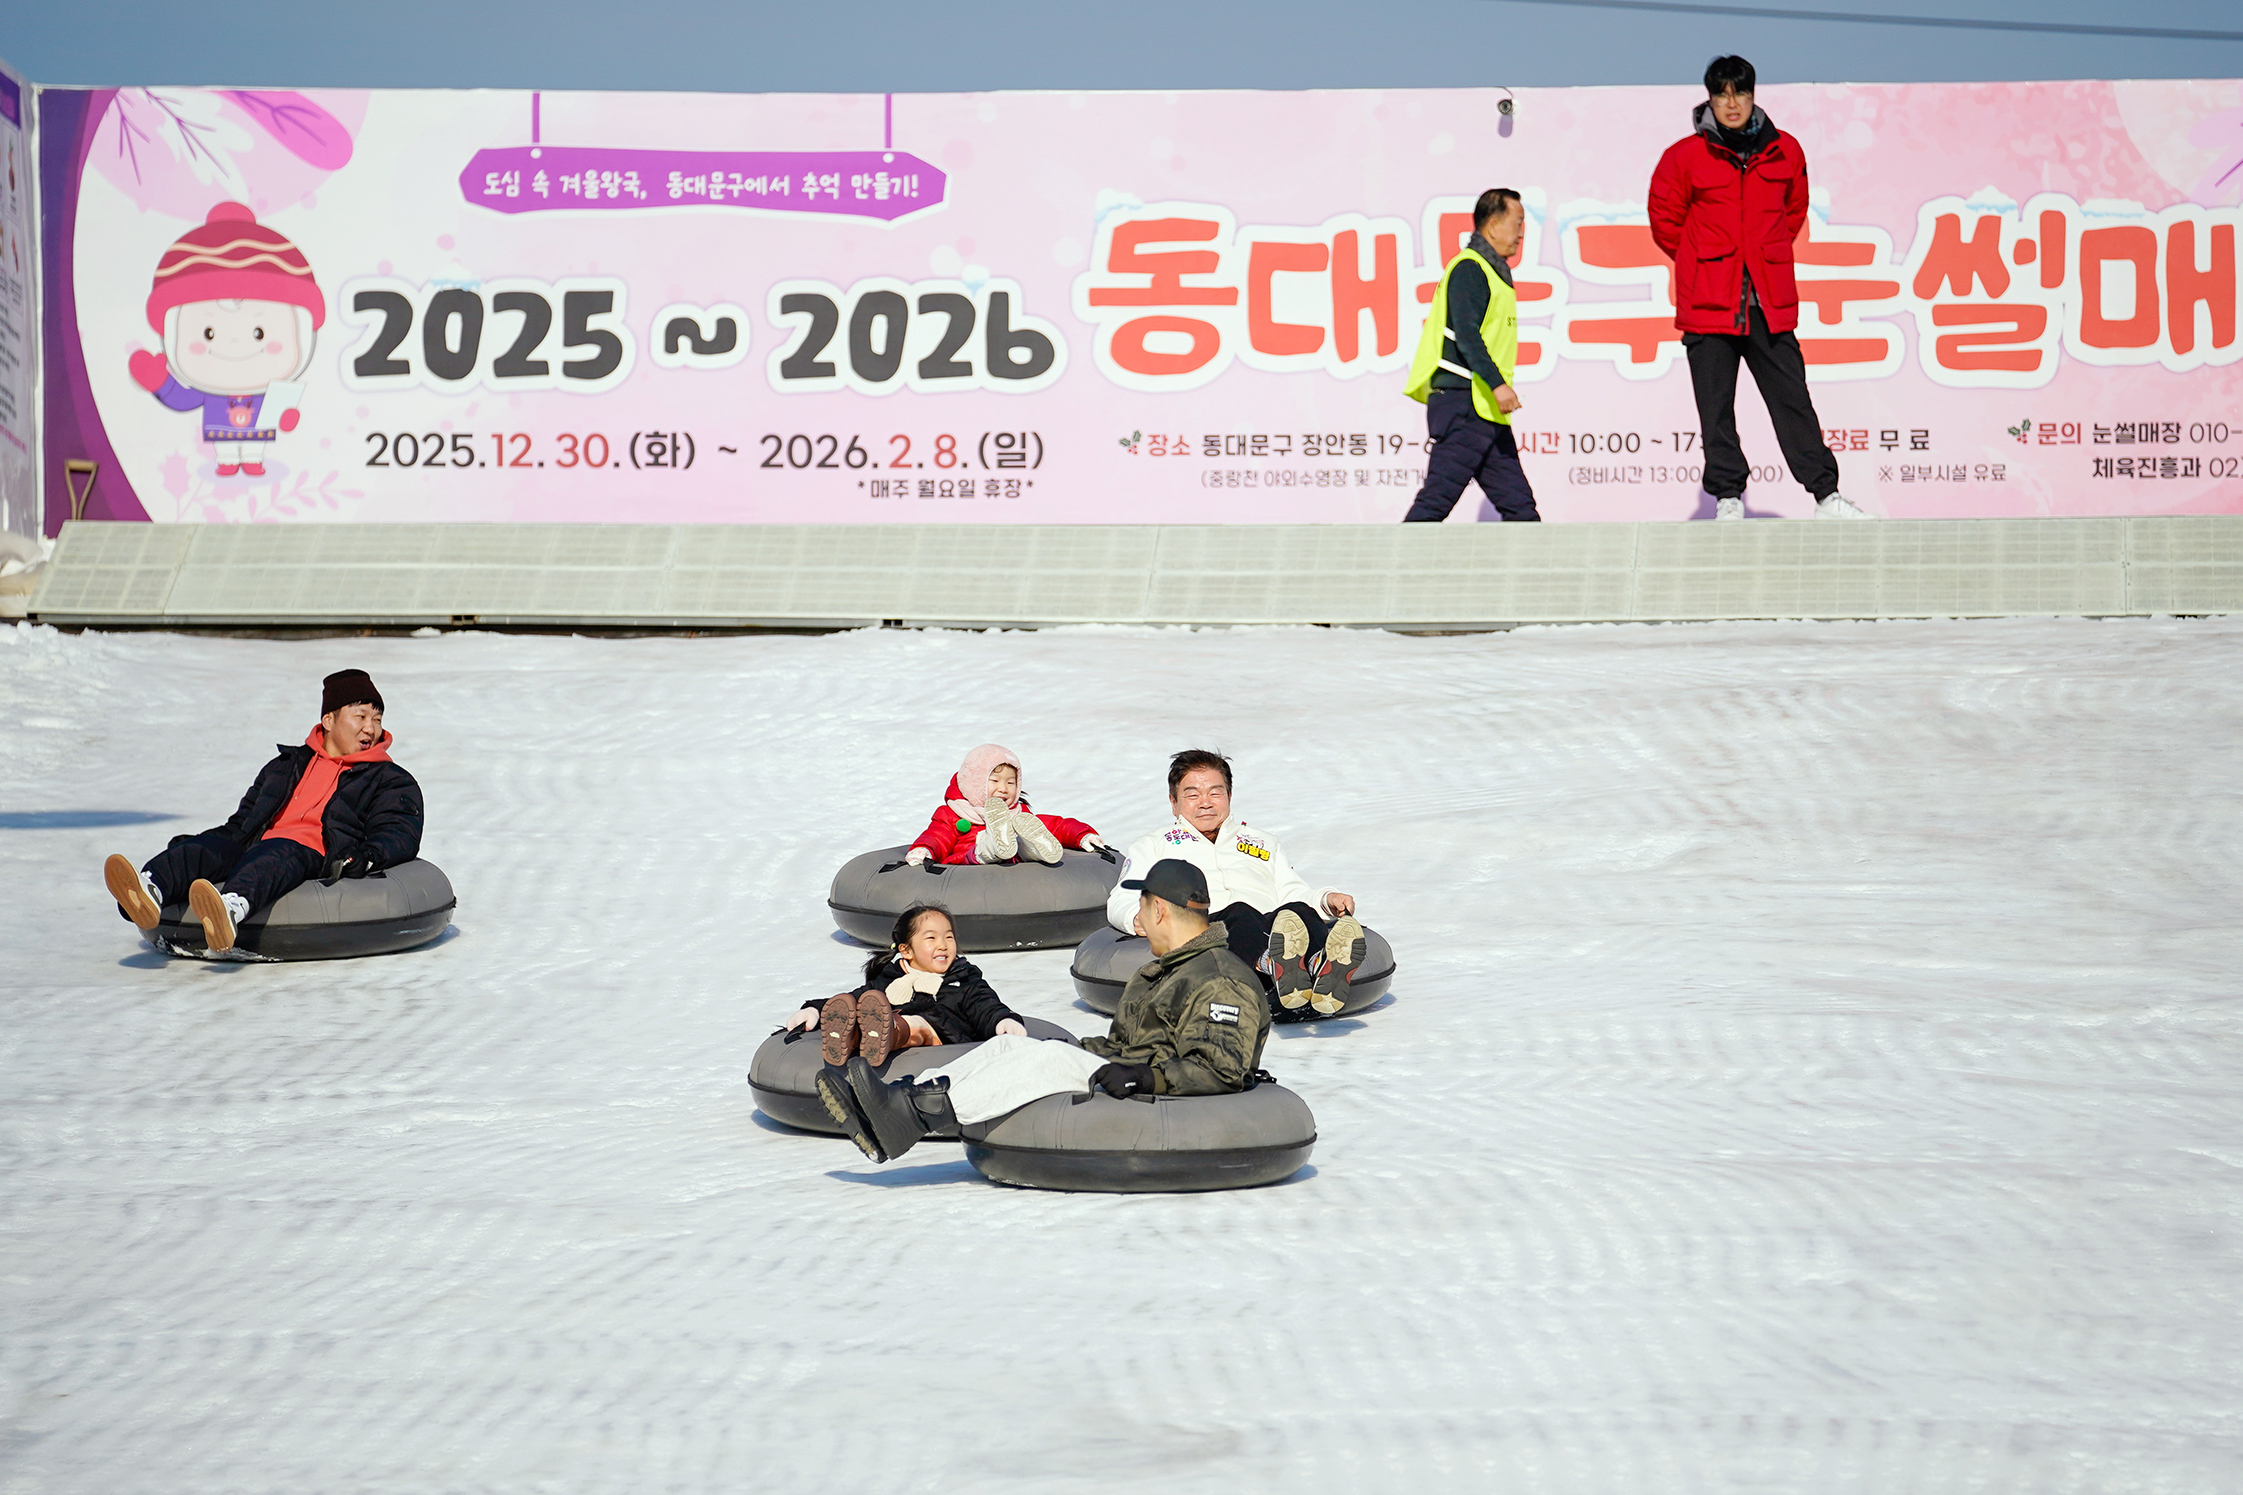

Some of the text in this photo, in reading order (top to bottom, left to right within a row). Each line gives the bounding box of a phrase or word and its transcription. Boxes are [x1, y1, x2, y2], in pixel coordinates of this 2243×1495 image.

[483, 168, 919, 201] 도심 속 겨울왕국, 동대문구에서 추억 만들기!
[353, 288, 623, 380] 2025
[780, 290, 1055, 382] 2026
[1147, 434, 1191, 457] 장소
[1202, 434, 1293, 457] 동대문구
[1302, 433, 1368, 457] 장안동
[1569, 432, 1641, 454] 10:00
[1821, 429, 1869, 451] 장료
[2037, 422, 2243, 446] 문의 눈썰매장 010-
[1200, 469, 1258, 489] (중랑천
[1263, 468, 1348, 488] 야외수영장
[1354, 469, 1370, 487] 및
[1568, 465, 1643, 486] (정비시간
[1899, 464, 1967, 483] 일부시설
[1974, 463, 2006, 482] 유료
[2092, 456, 2243, 479] 체육진흥과 02
[917, 478, 975, 499] 월요일
